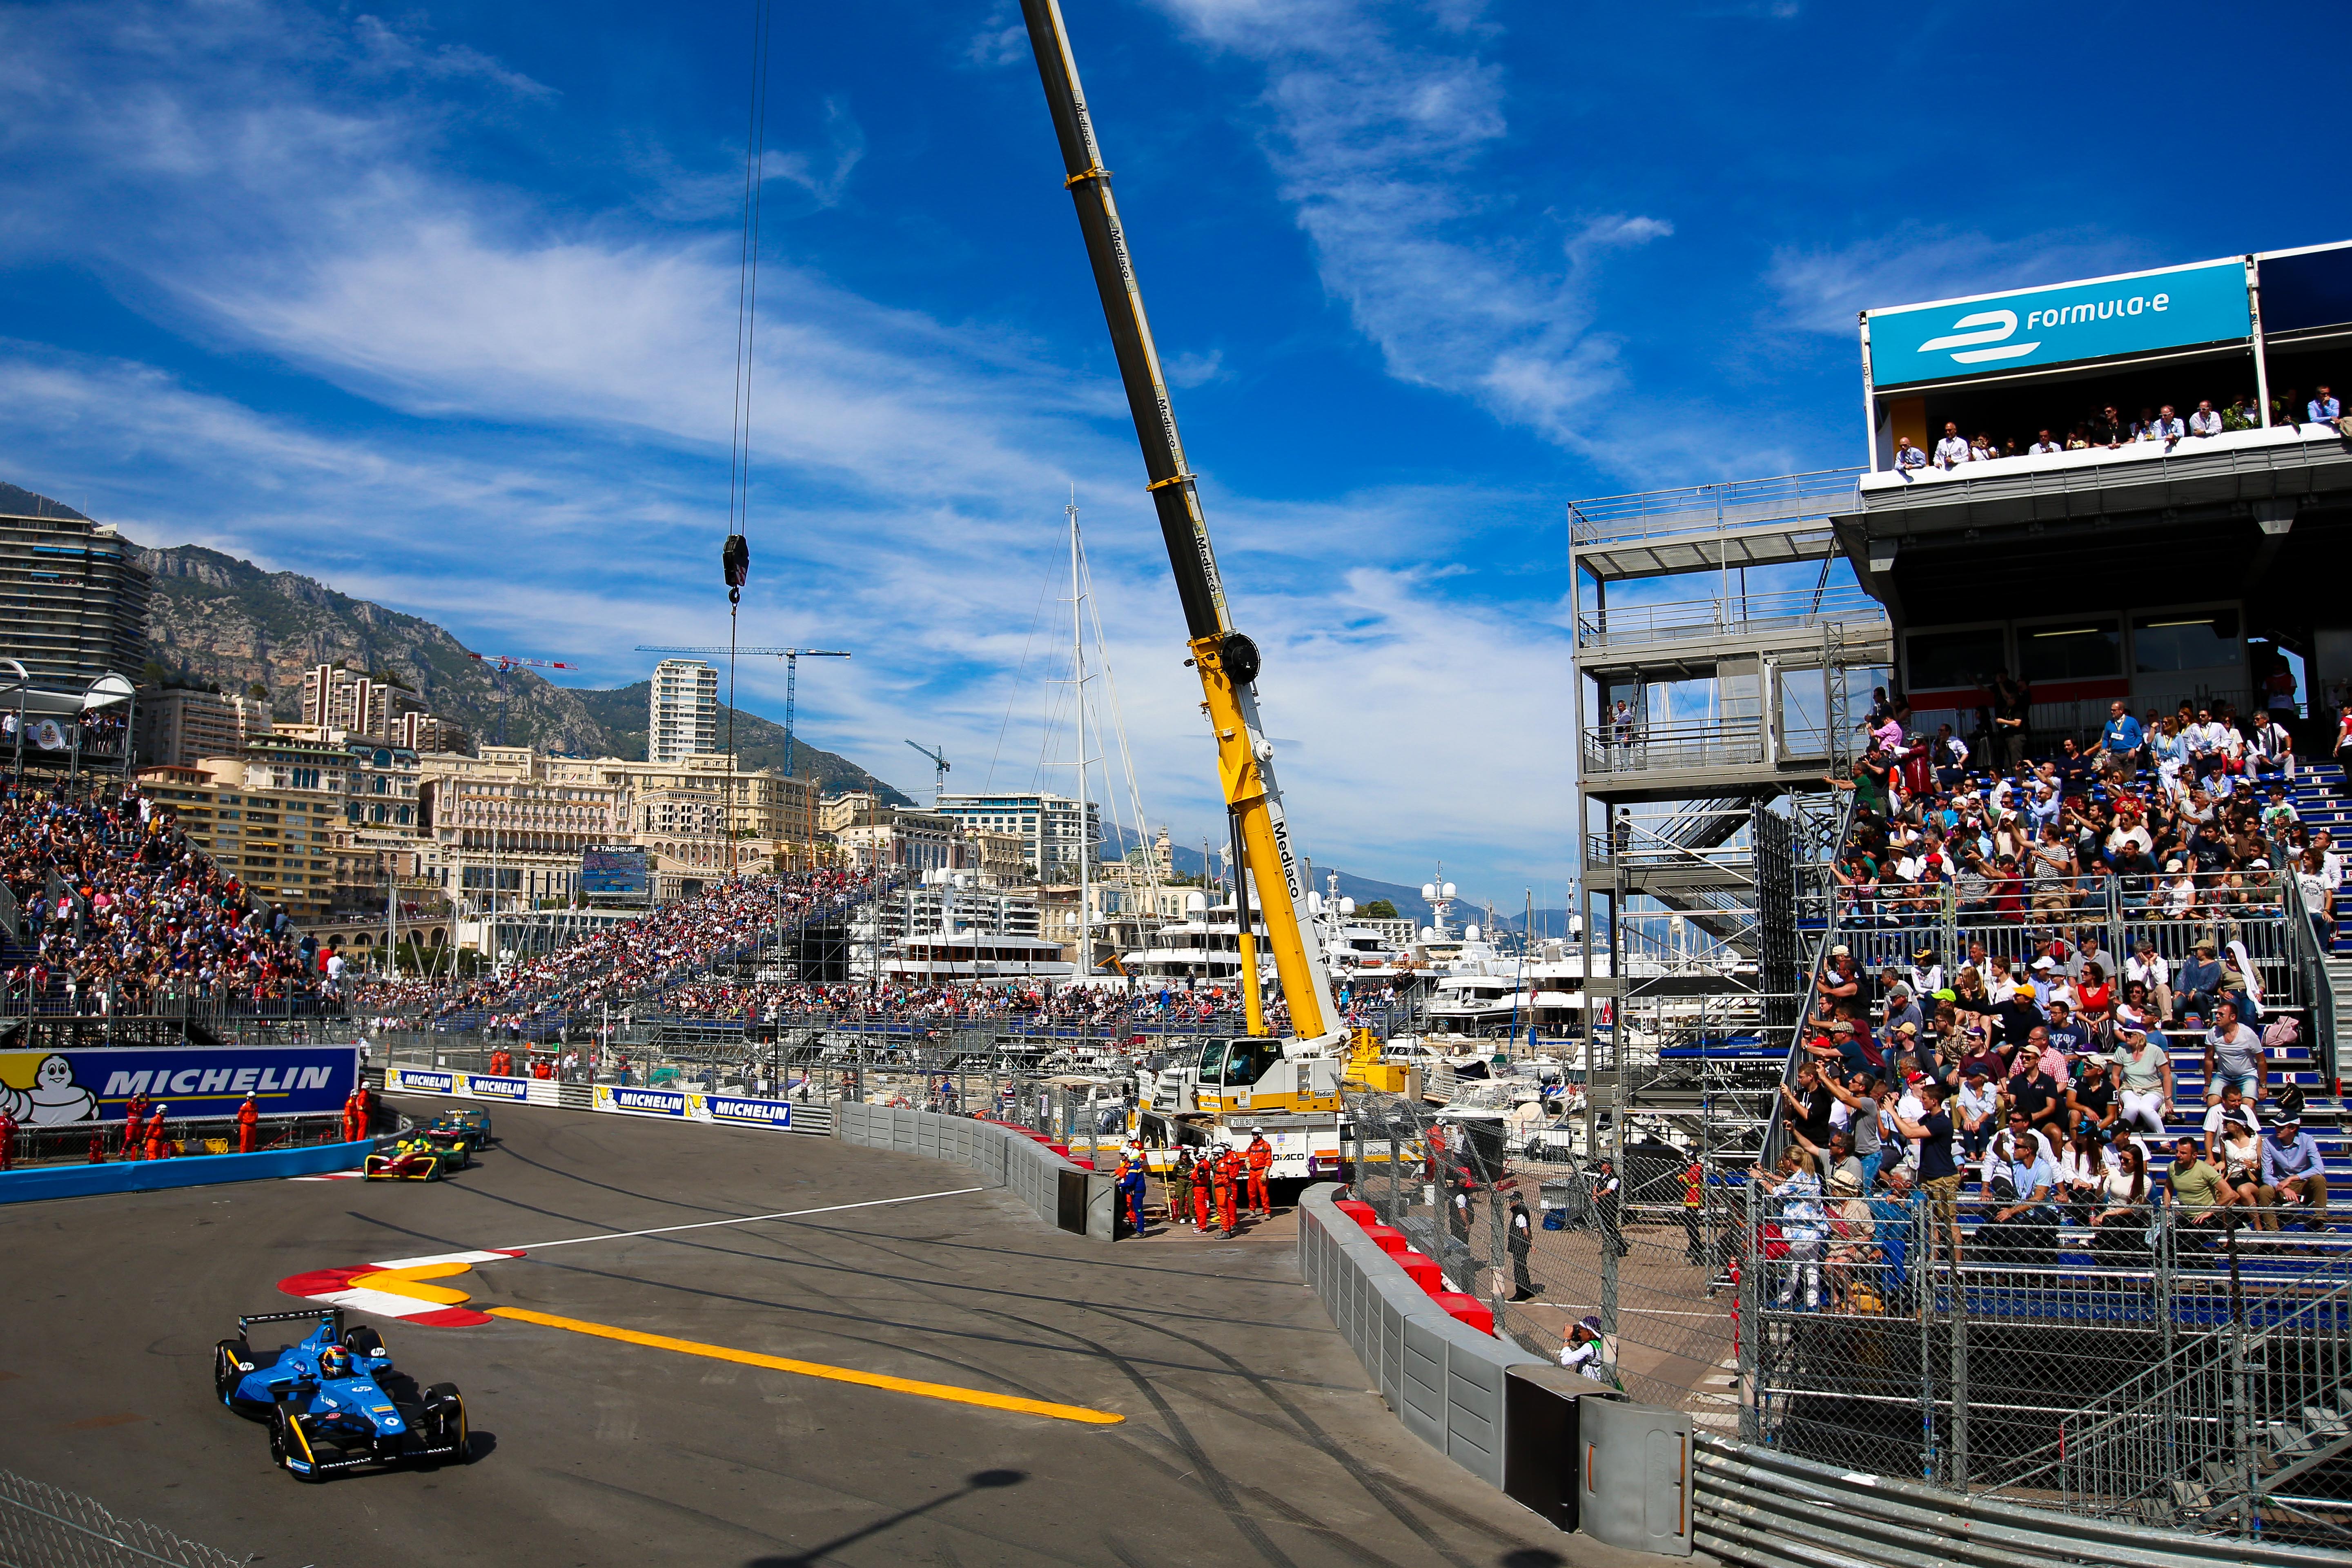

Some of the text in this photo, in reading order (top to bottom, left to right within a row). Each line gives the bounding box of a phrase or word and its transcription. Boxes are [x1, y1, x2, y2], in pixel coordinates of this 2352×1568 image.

[1075, 102, 1091, 146] Mediaco
[1111, 230, 1129, 278] Mediaco
[1157, 399, 1176, 448] Mediaco
[1196, 536, 1216, 592] Mediaco
[1272, 821, 1299, 899] Mediaco
[2277, 1049, 2282, 1057] L
[103, 1066, 332, 1095] MICHELIN
[405, 1074, 451, 1088] MICHELIN
[2285, 1073, 2291, 1082] K
[474, 1079, 526, 1095] MICHELIN
[620, 1092, 683, 1110] MICHELIN
[715, 1101, 788, 1120] MICHELIN
[292, 1462, 309, 1470] MICHELIN
[321, 1457, 372, 1469] RENAULT
